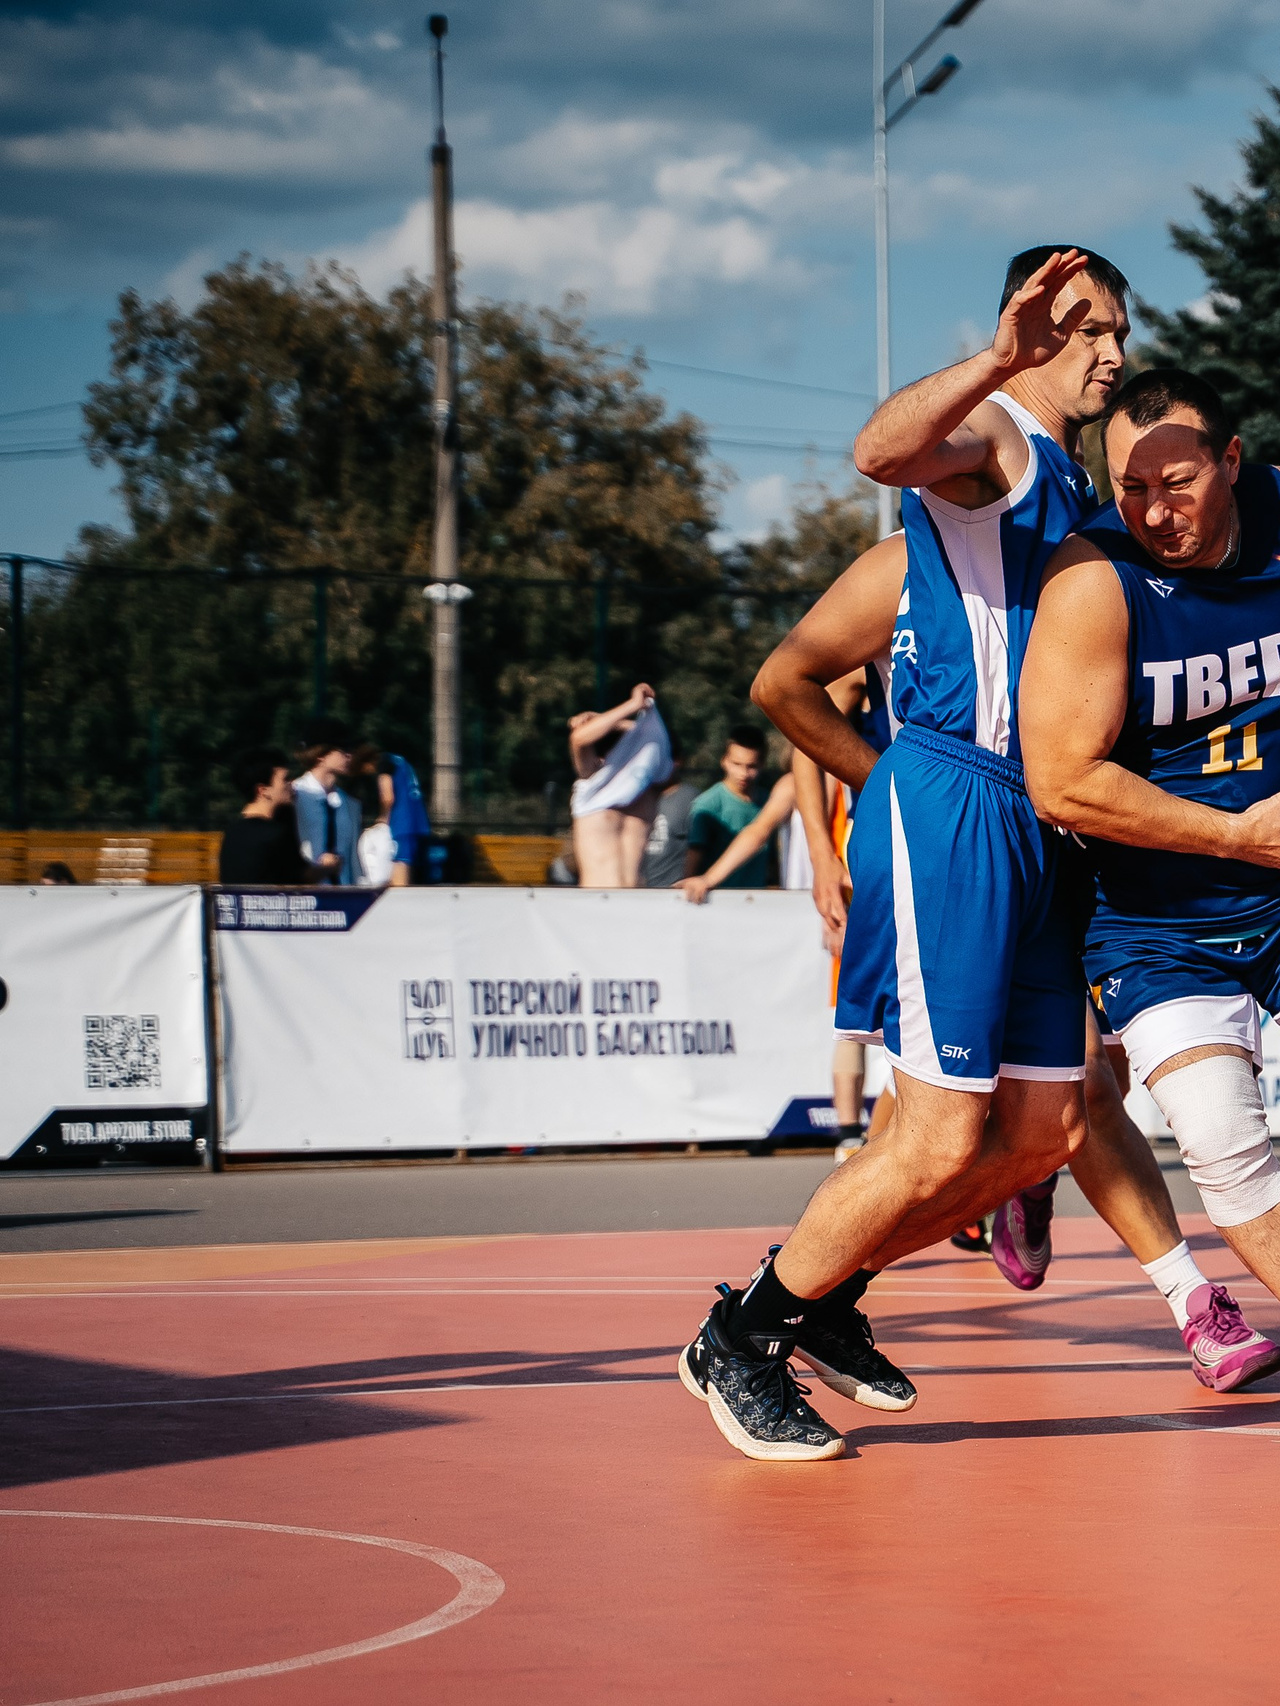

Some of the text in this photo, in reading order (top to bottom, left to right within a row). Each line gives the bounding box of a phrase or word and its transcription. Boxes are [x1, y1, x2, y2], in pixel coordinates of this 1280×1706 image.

[1202, 721, 1263, 774] 11
[469, 973, 661, 1016] ТВЕРСКОЙ ЦЕНТР
[471, 1020, 737, 1058] УЛИЧНОГО БАСКЕТБОЛА
[940, 1044, 971, 1060] STK
